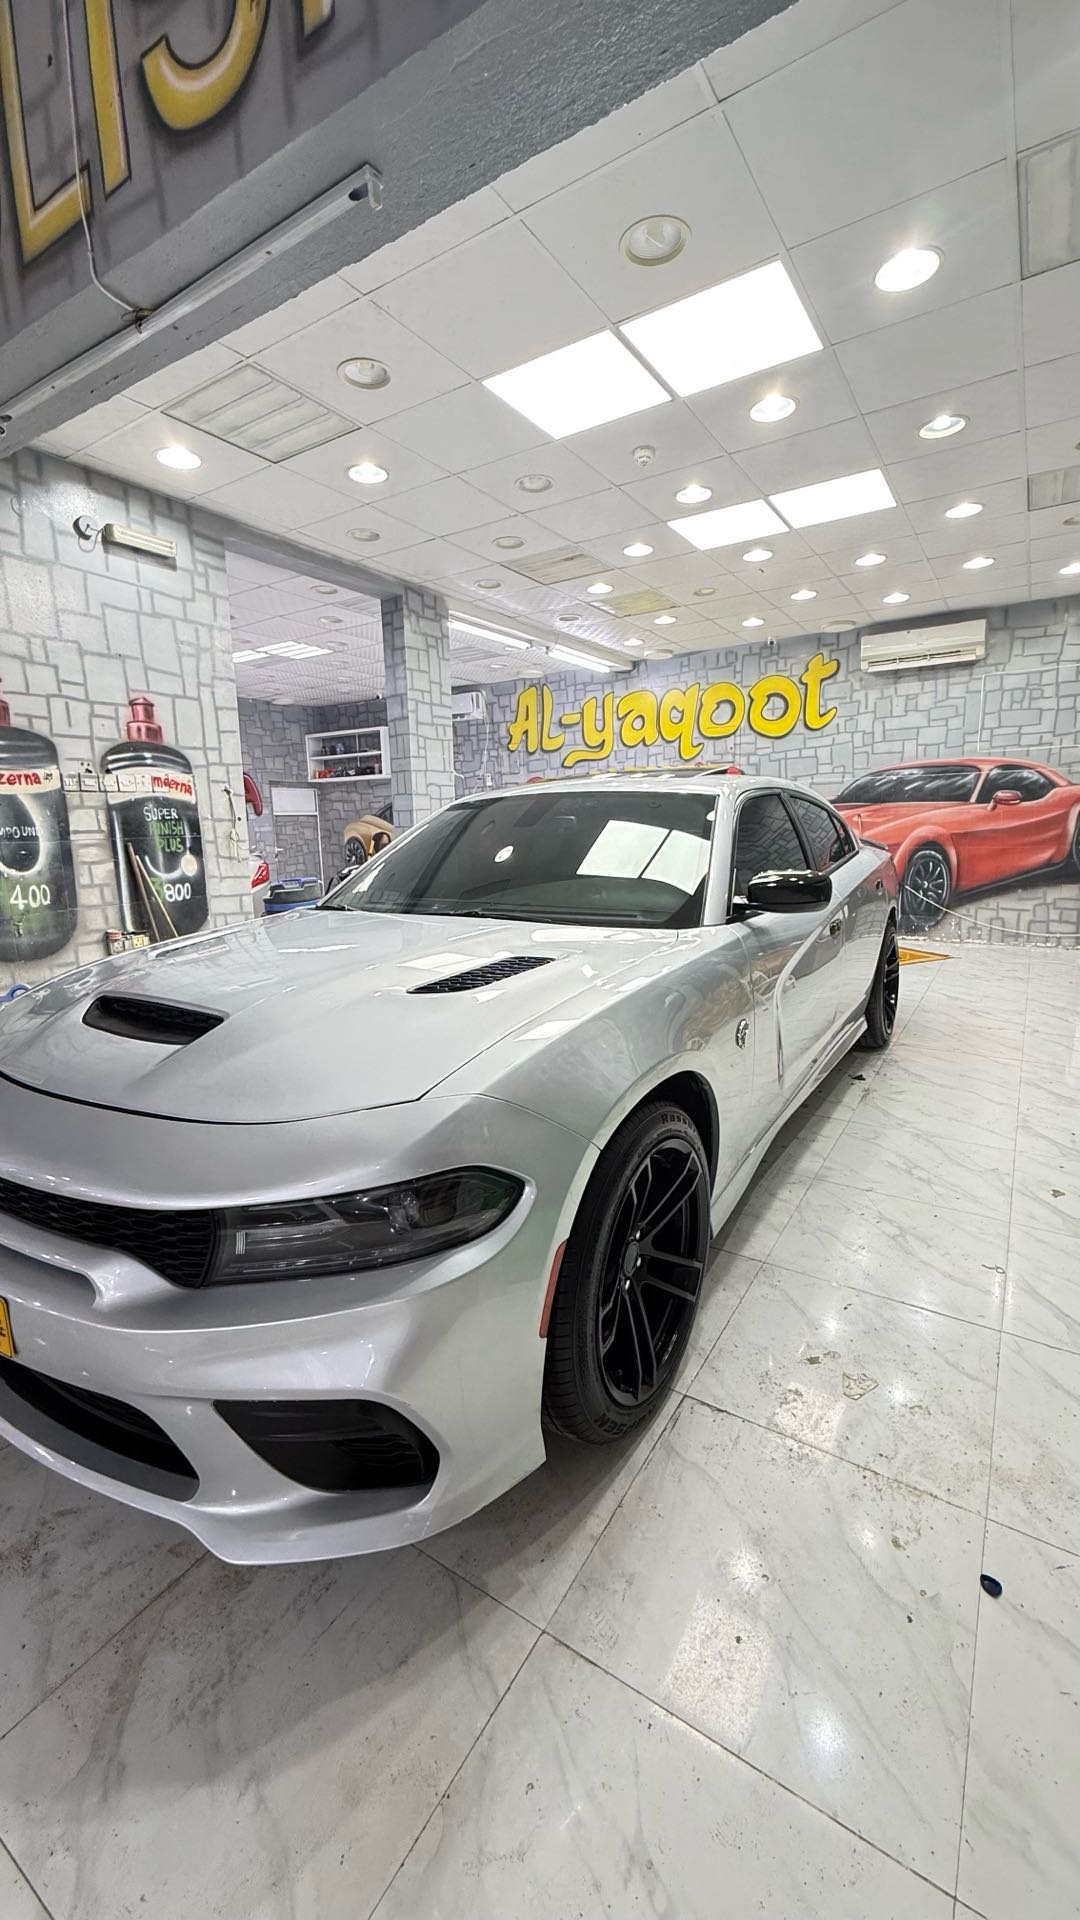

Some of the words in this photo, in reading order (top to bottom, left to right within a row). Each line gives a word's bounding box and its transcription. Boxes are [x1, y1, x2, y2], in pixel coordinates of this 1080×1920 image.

[507, 652, 840, 767] AL-yaqoot
[143, 806, 179, 821] SUPER
[156, 837, 184, 853] PLUS
[9, 884, 51, 910] 400
